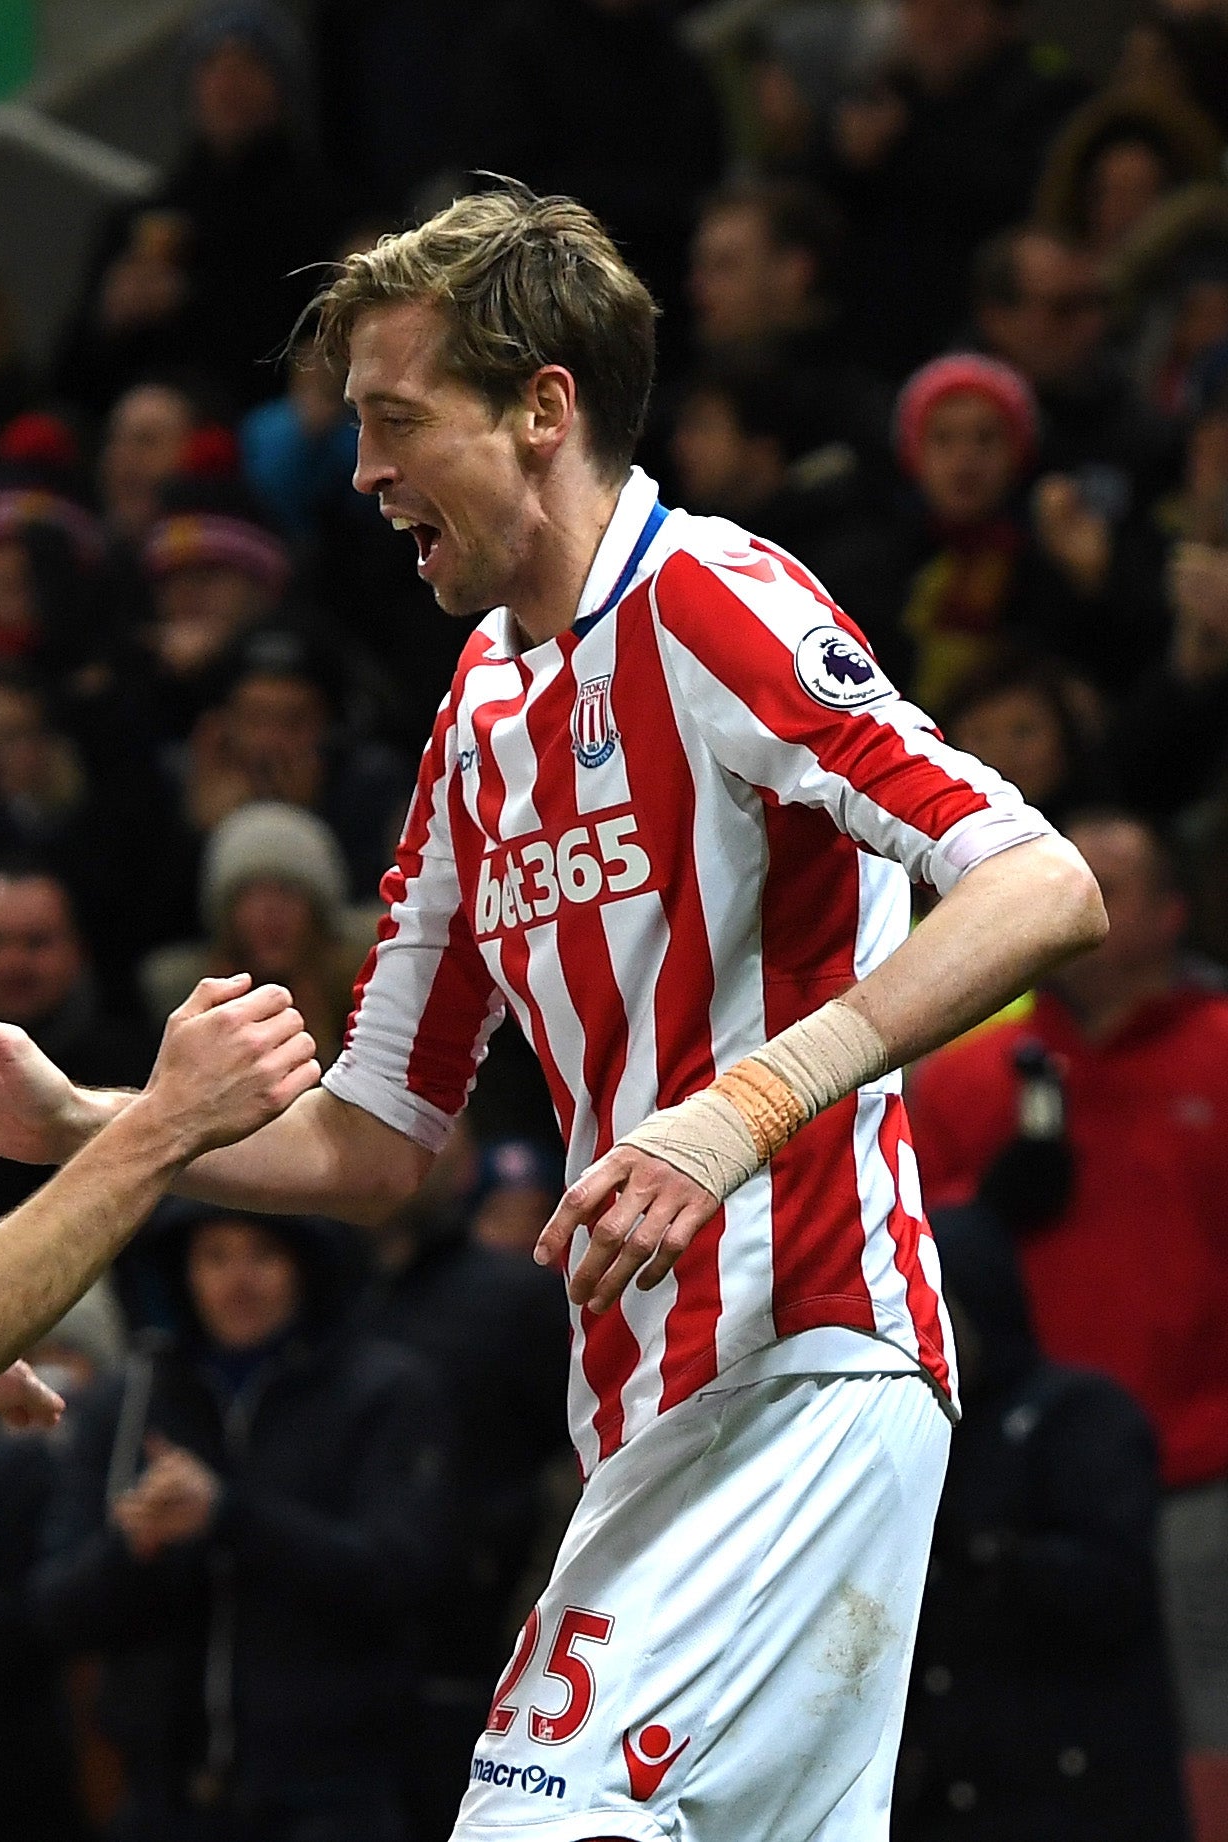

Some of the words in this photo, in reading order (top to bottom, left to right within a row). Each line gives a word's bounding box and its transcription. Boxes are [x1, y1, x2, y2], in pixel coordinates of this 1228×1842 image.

[580, 680, 608, 697] STOKE
[475, 814, 651, 935] bet365
[485, 1604, 615, 1746] 25
[472, 1758, 566, 1799] macron
